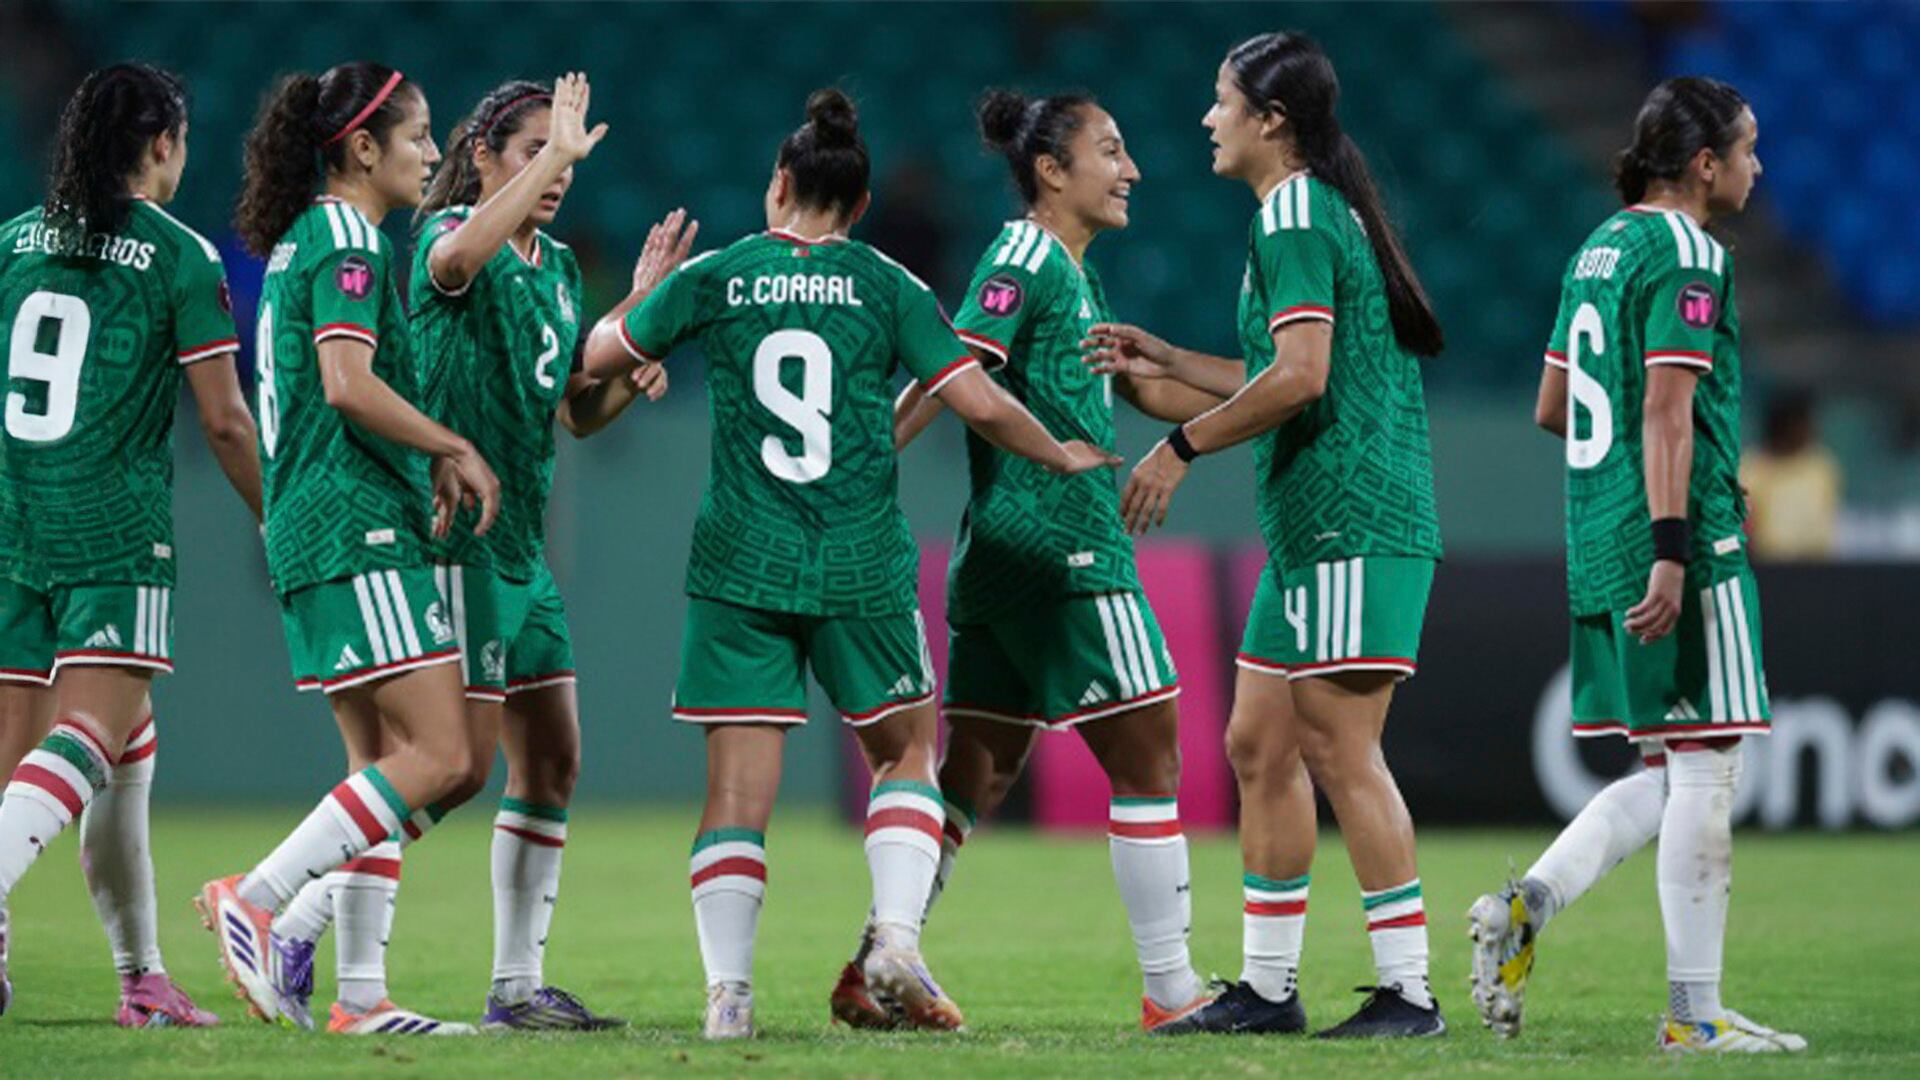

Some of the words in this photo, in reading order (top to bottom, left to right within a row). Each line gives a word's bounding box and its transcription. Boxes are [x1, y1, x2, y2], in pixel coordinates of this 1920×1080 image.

[726, 273, 863, 307] C.CORRAL
[4, 290, 91, 441] 9
[535, 324, 559, 389] 2
[753, 329, 833, 483] 9
[1566, 302, 1613, 469] 6
[1284, 585, 1308, 653] 4
